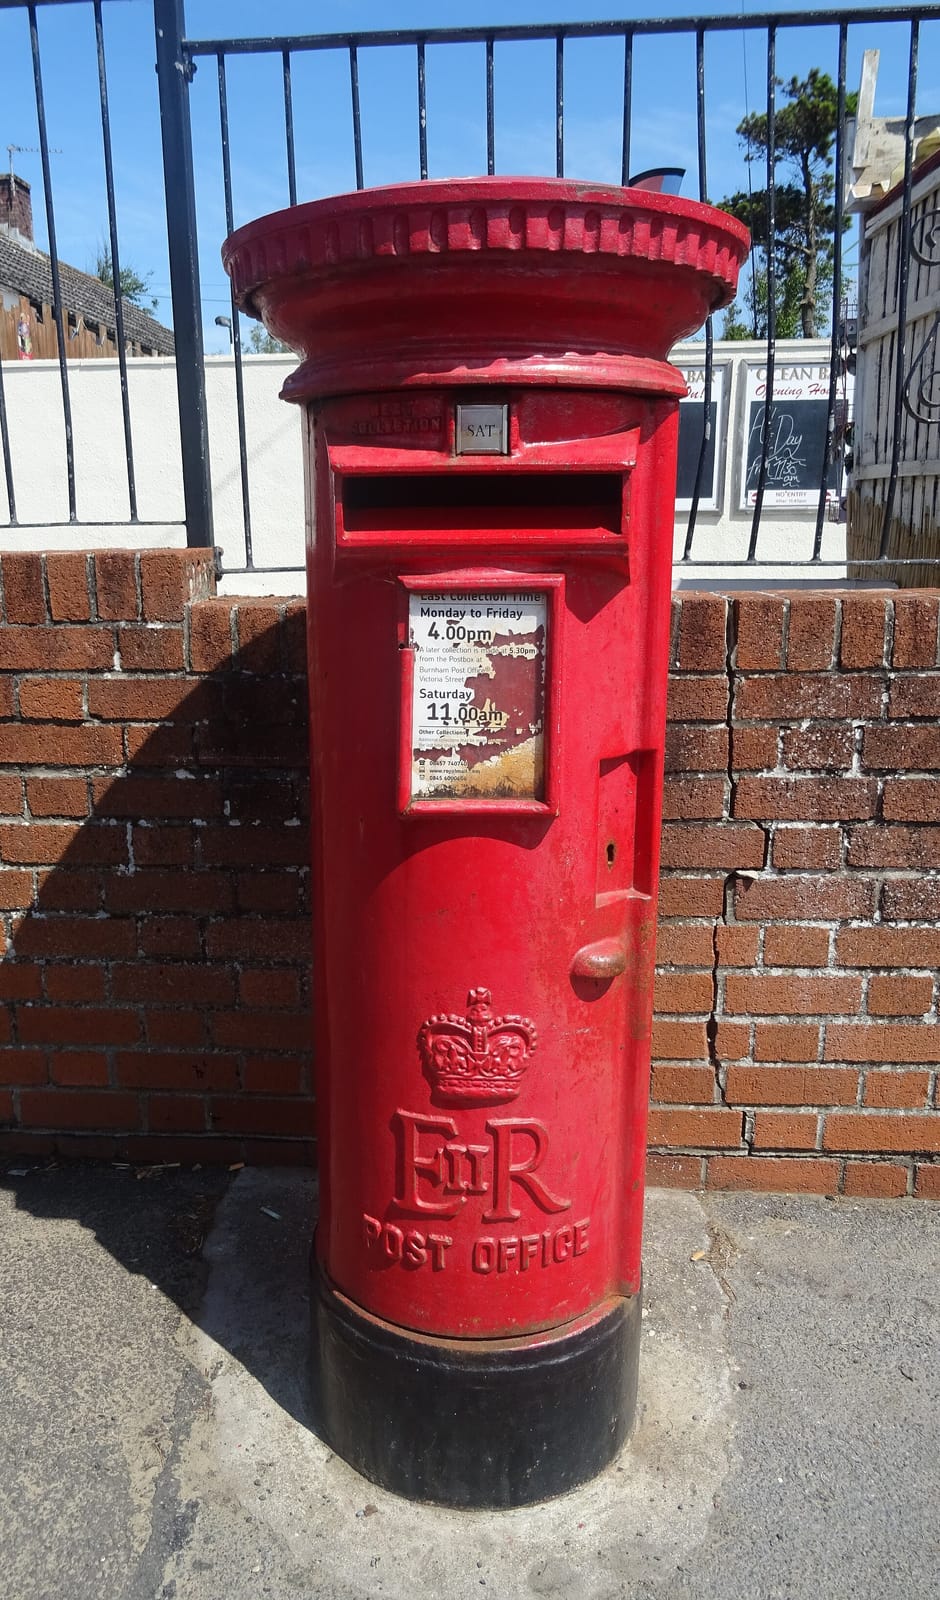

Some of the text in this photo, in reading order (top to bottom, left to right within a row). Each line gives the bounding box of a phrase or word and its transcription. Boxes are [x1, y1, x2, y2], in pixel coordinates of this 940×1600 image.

[467, 424, 495, 437] SAT
[420, 592, 446, 602] Last
[450, 592, 508, 602] Collection
[420, 607, 523, 620] Monday to Friday
[427, 621, 492, 643] 4.00pm
[442, 646, 472, 654] collection
[509, 647, 536, 655] 5.30pm
[419, 666, 450, 674] Burnham
[451, 666, 465, 674] Post
[420, 688, 472, 701] Saturday
[427, 702, 503, 722] 11.00am
[363, 1213, 590, 1274] POST OFFICE
